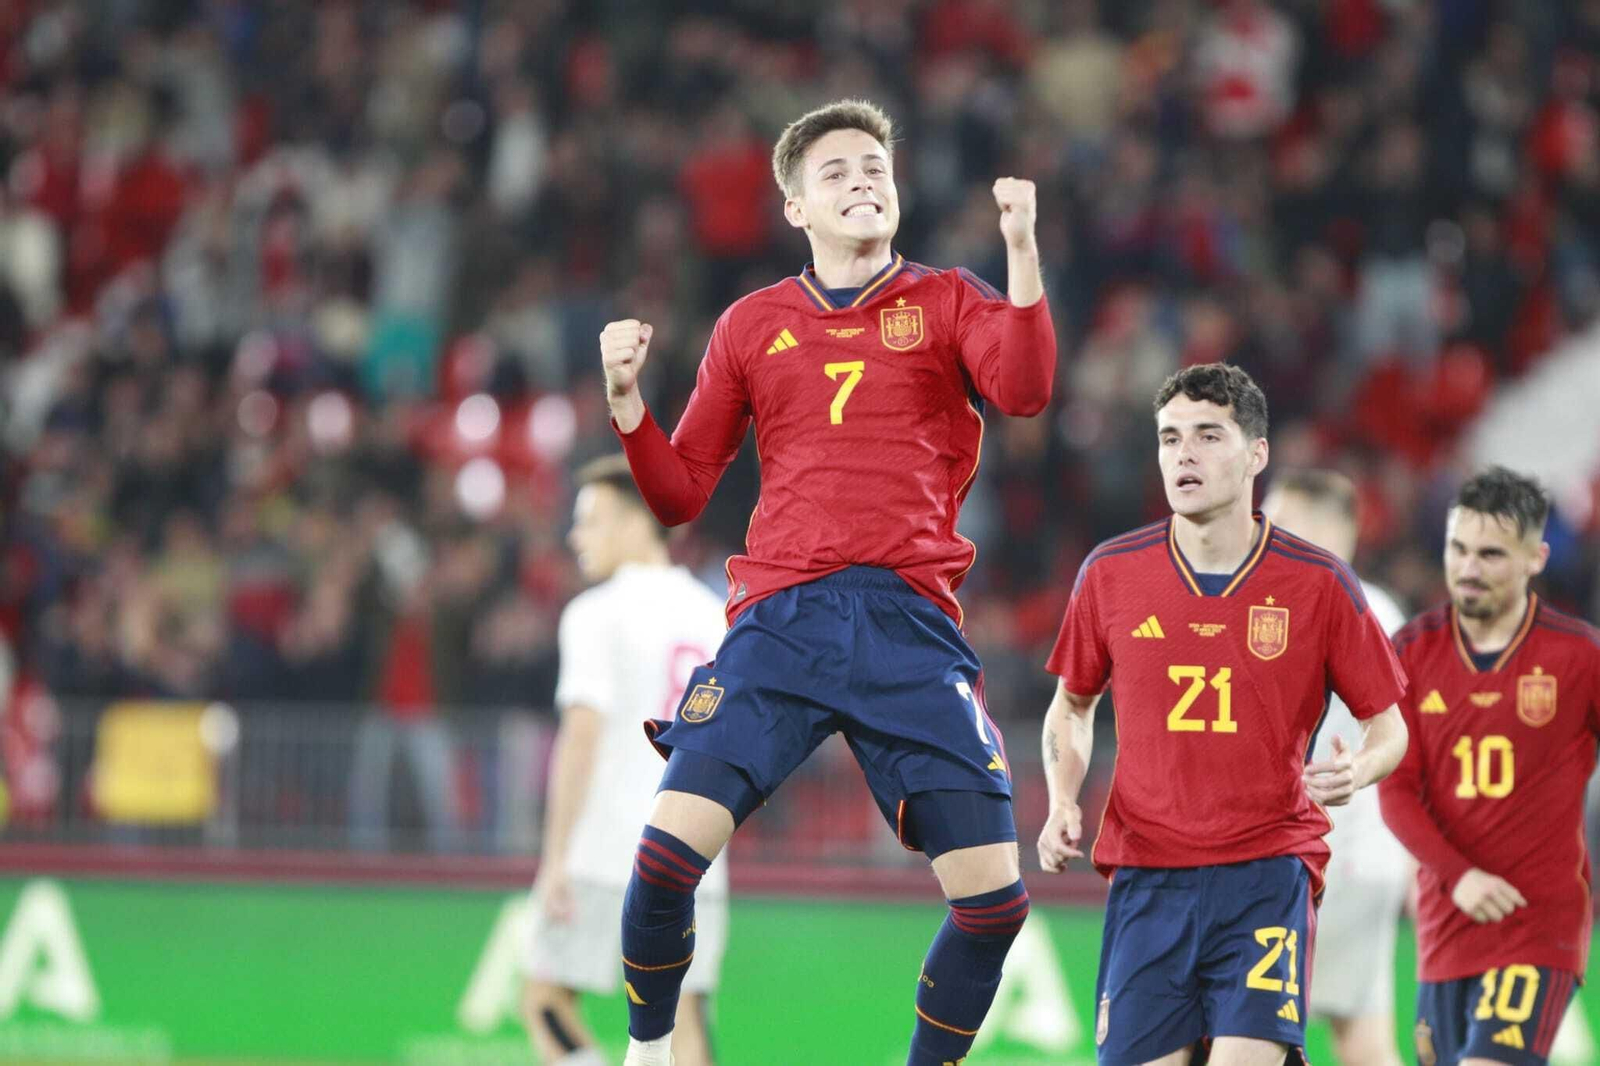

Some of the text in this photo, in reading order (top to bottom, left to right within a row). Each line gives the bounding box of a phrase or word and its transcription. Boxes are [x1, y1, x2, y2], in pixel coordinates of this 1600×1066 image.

[824, 361, 865, 425] 7
[955, 682, 991, 745] 7
[1167, 666, 1238, 733] 21
[1453, 735, 1515, 799] 10
[1246, 926, 1299, 996] 21
[1475, 964, 1540, 1023] 10
